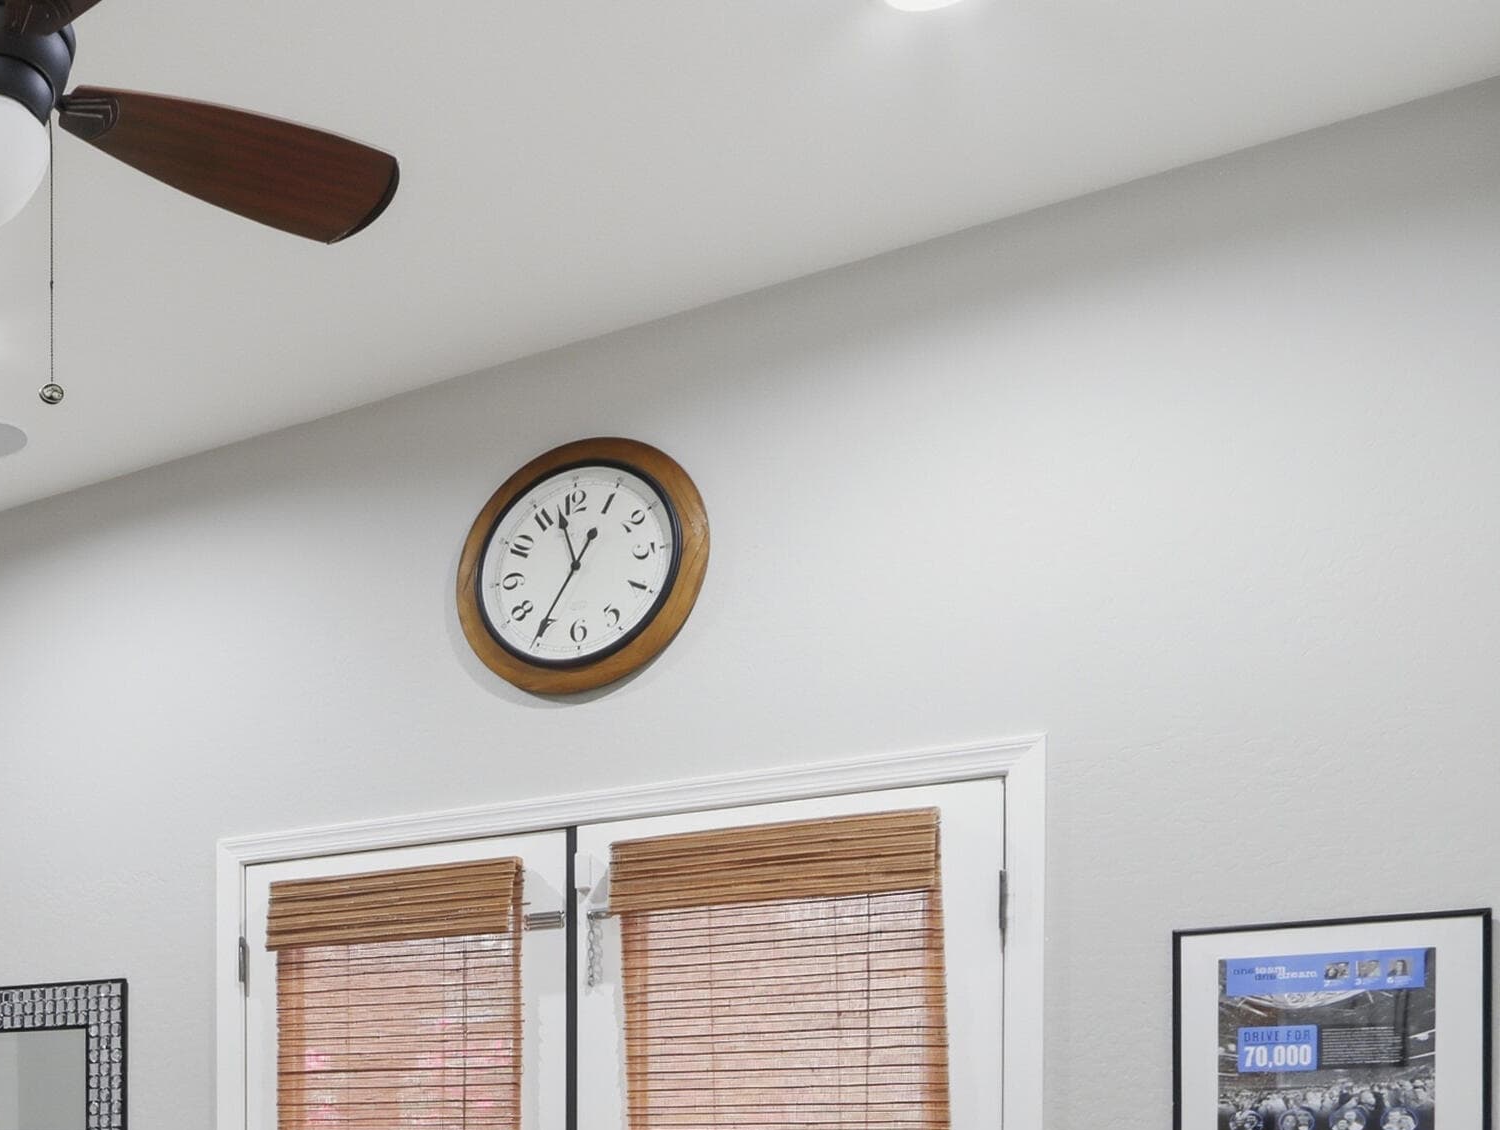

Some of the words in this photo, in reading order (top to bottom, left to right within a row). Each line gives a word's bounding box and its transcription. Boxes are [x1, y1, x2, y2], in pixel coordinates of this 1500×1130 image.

[564, 489, 587, 516] 12
[601, 492, 616, 515] 1
[533, 508, 554, 532] 11
[622, 508, 646, 534] 2
[509, 534, 534, 559] 10
[632, 541, 656, 561] 3
[502, 572, 526, 592] 9
[510, 599, 534, 623] 8
[603, 603, 621, 628] 5
[569, 619, 588, 643] 6
[1243, 1030, 1280, 1042] DRIVE
[1286, 1029, 1311, 1041] FOR
[1243, 1044, 1312, 1068] 70,000
